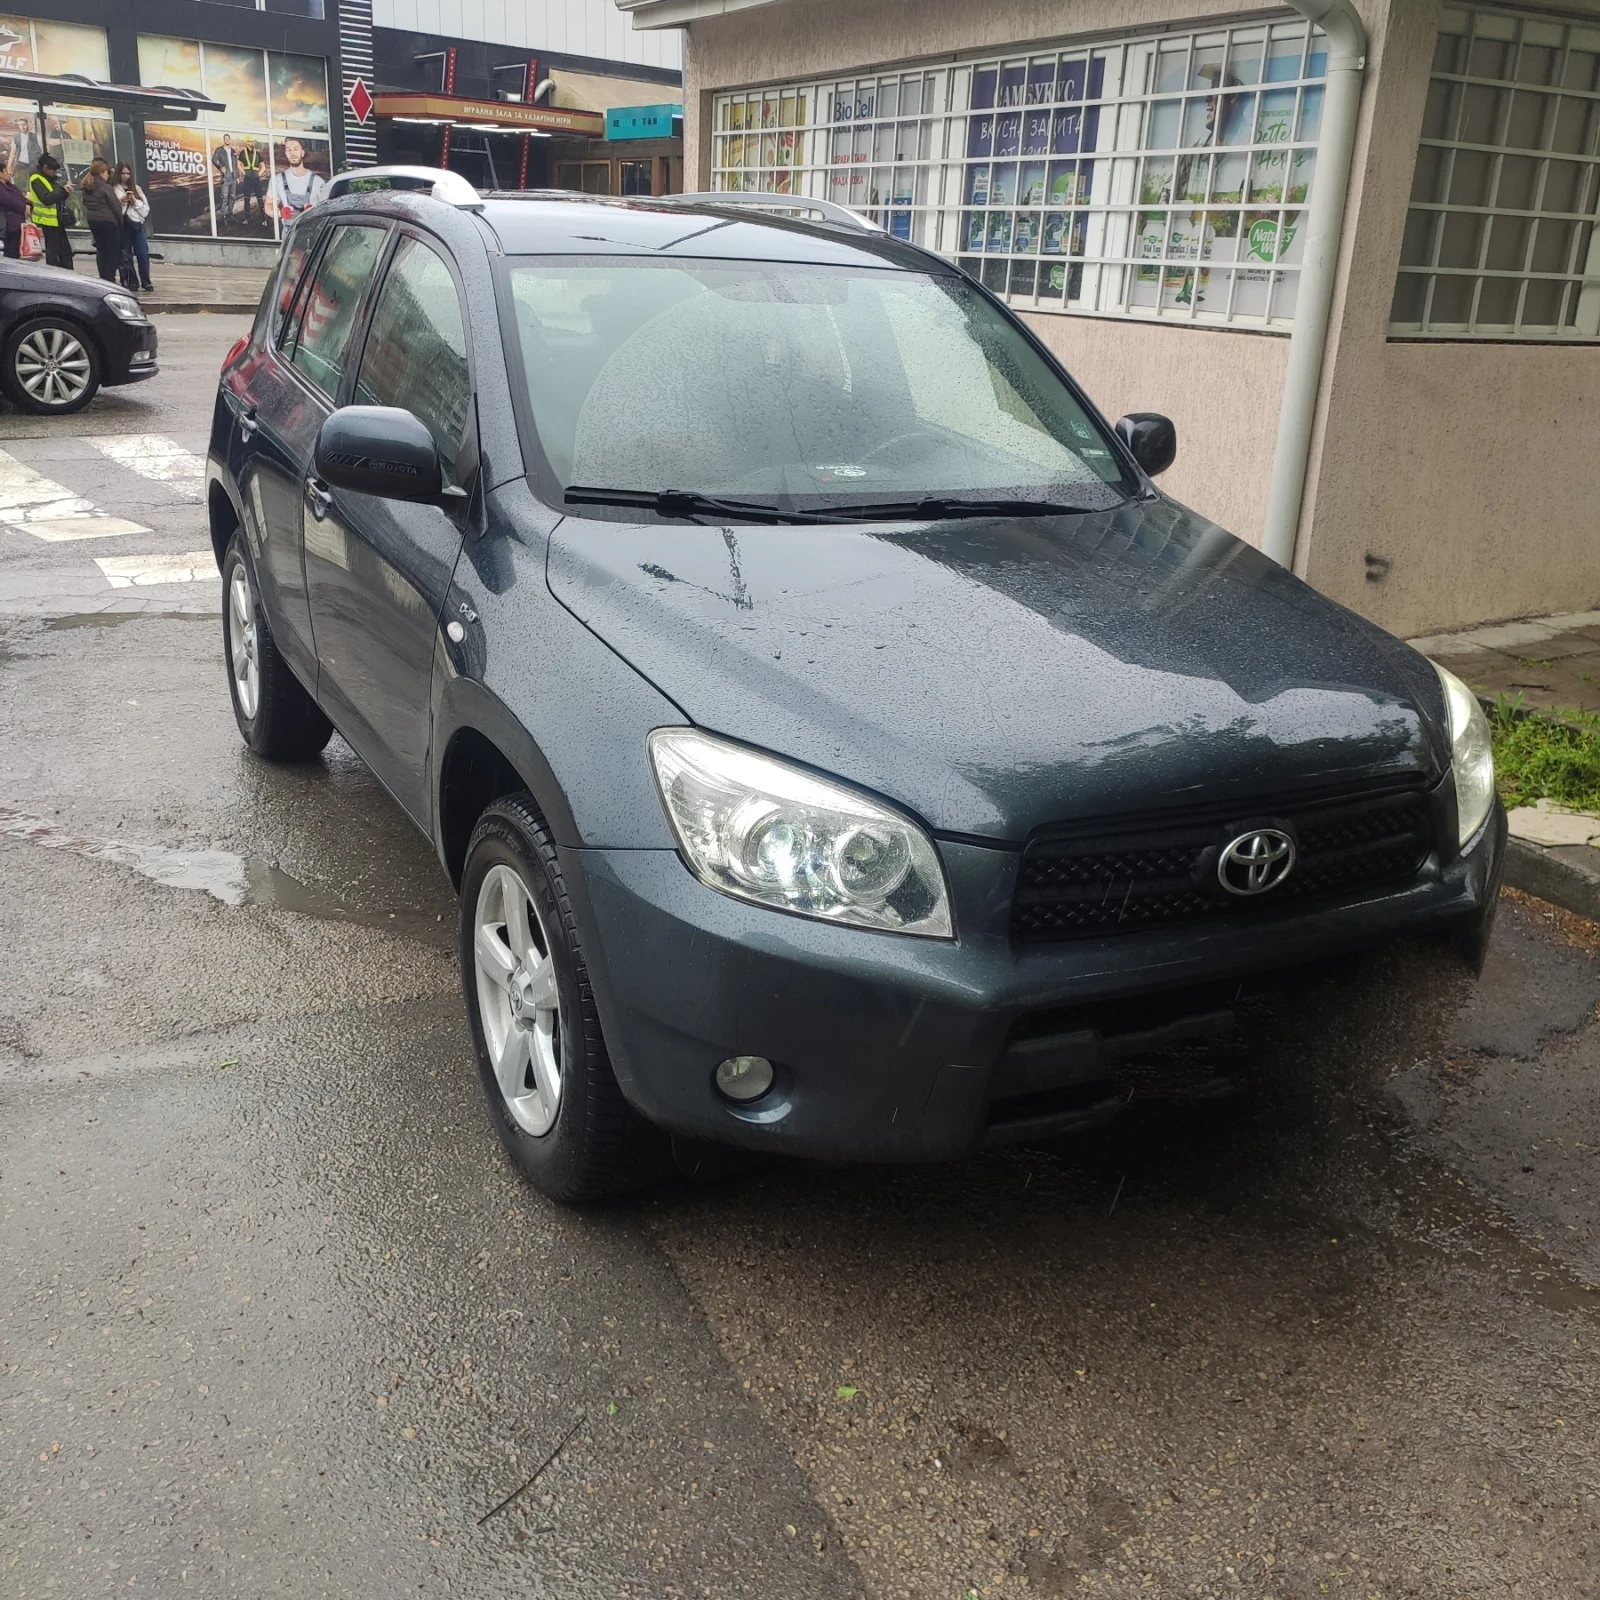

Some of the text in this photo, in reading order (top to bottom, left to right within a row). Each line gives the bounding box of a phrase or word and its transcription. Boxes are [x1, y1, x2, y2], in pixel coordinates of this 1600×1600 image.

[463, 106, 493, 116] ИГРАЛНА
[495, 109, 512, 118] ЗАЛА
[524, 113, 555, 123] ХАЗАРТНИ
[555, 116, 571, 125] ИГРИ
[1251, 118, 1294, 144] Bette
[145, 139, 180, 150] PREMIUM
[145, 148, 204, 164] РАБОТНО
[851, 152, 867, 163] ТАВИ
[1023, 145, 1058, 166] РИПА
[1257, 150, 1307, 171] Hers
[146, 159, 206, 175] ОБЛЕКЛО
[1252, 228, 1293, 243] Natue's
